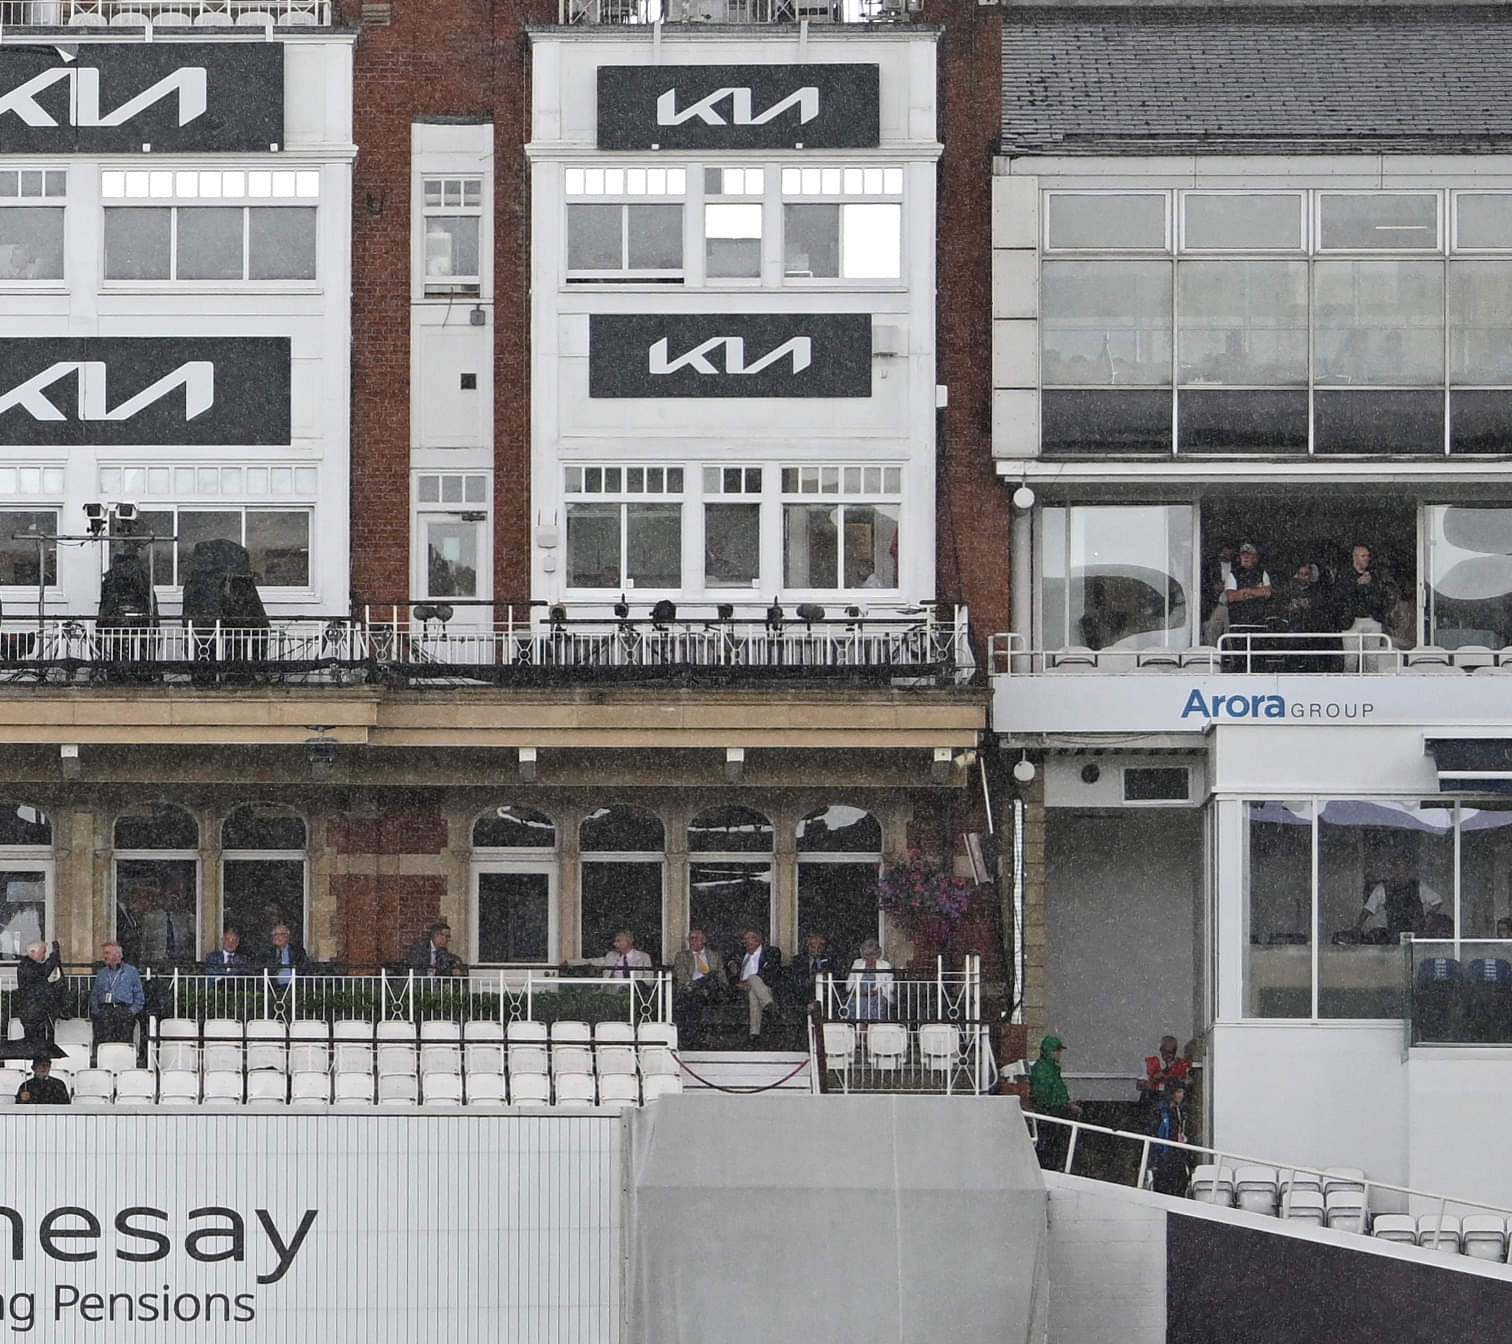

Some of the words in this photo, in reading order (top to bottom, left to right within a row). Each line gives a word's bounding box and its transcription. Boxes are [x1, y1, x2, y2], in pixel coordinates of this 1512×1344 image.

[1181, 688, 1285, 719] Arora
[1291, 703, 1375, 719] GROUP
[54, 1281, 256, 1324] Pensions
